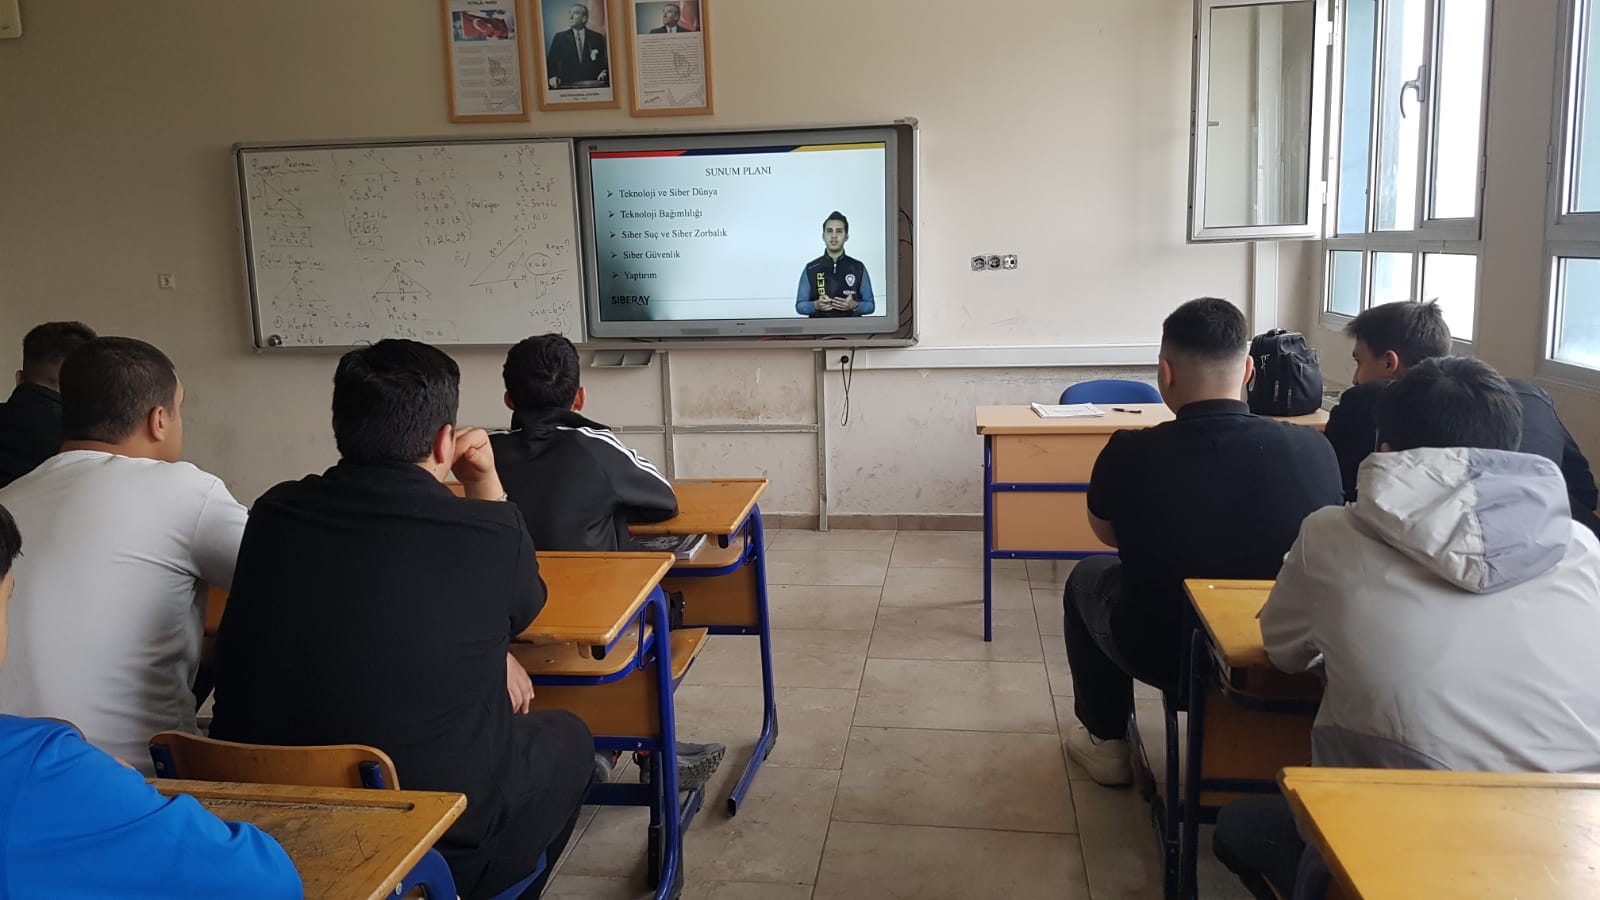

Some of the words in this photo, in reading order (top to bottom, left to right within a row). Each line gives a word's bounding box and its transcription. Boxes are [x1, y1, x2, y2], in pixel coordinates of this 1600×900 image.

[705, 167, 740, 177] SUNUM
[743, 166, 772, 176] PLANI
[618, 188, 656, 199] Teknoloji
[669, 188, 690, 197] Siber
[692, 187, 718, 198] Dünya
[620, 209, 657, 220] Teknoloji
[659, 209, 702, 220] Bağımlılığı
[621, 231, 642, 239] Siber
[644, 230, 658, 240] Suç
[672, 230, 692, 238] Siber
[694, 228, 728, 238] Zorbalık
[623, 251, 643, 259] Siber
[645, 250, 680, 259] Güvenlik
[624, 271, 657, 281] Yaptırım
[817, 272, 825, 294] BER
